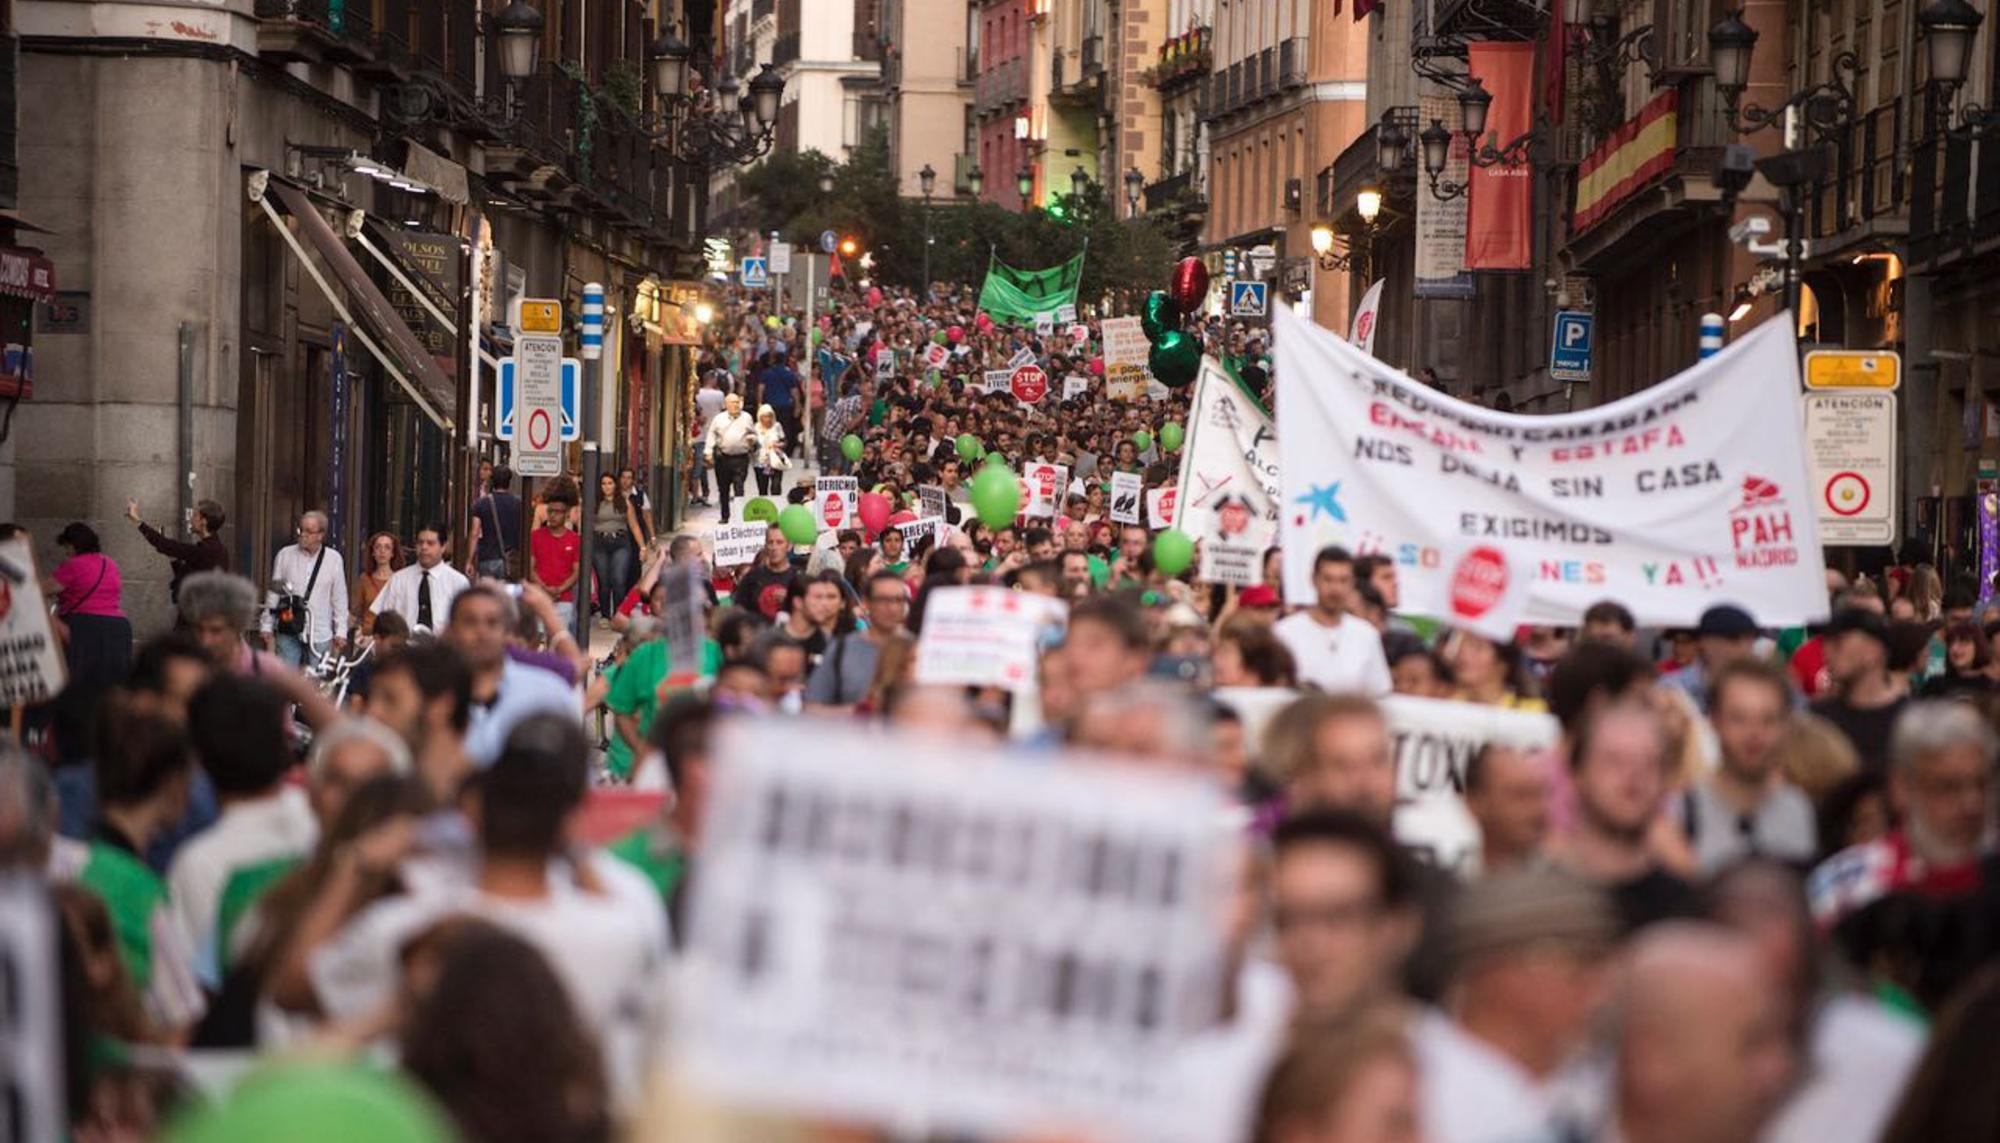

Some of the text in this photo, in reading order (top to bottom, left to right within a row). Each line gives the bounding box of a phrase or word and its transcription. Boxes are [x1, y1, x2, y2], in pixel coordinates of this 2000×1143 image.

[1565, 322, 1585, 347] P
[1016, 372, 1042, 382] STOP
[1815, 397, 1883, 409] ATENCIÓN
[1354, 436, 1413, 466] NOS
[1550, 477, 1603, 497] SIN
[1637, 461, 1722, 493] CASA
[715, 530, 729, 541] Las
[1460, 513, 1614, 544] EXIGIMOS
[1731, 511, 1792, 549] PAH
[1735, 547, 1799, 568] MADRID
